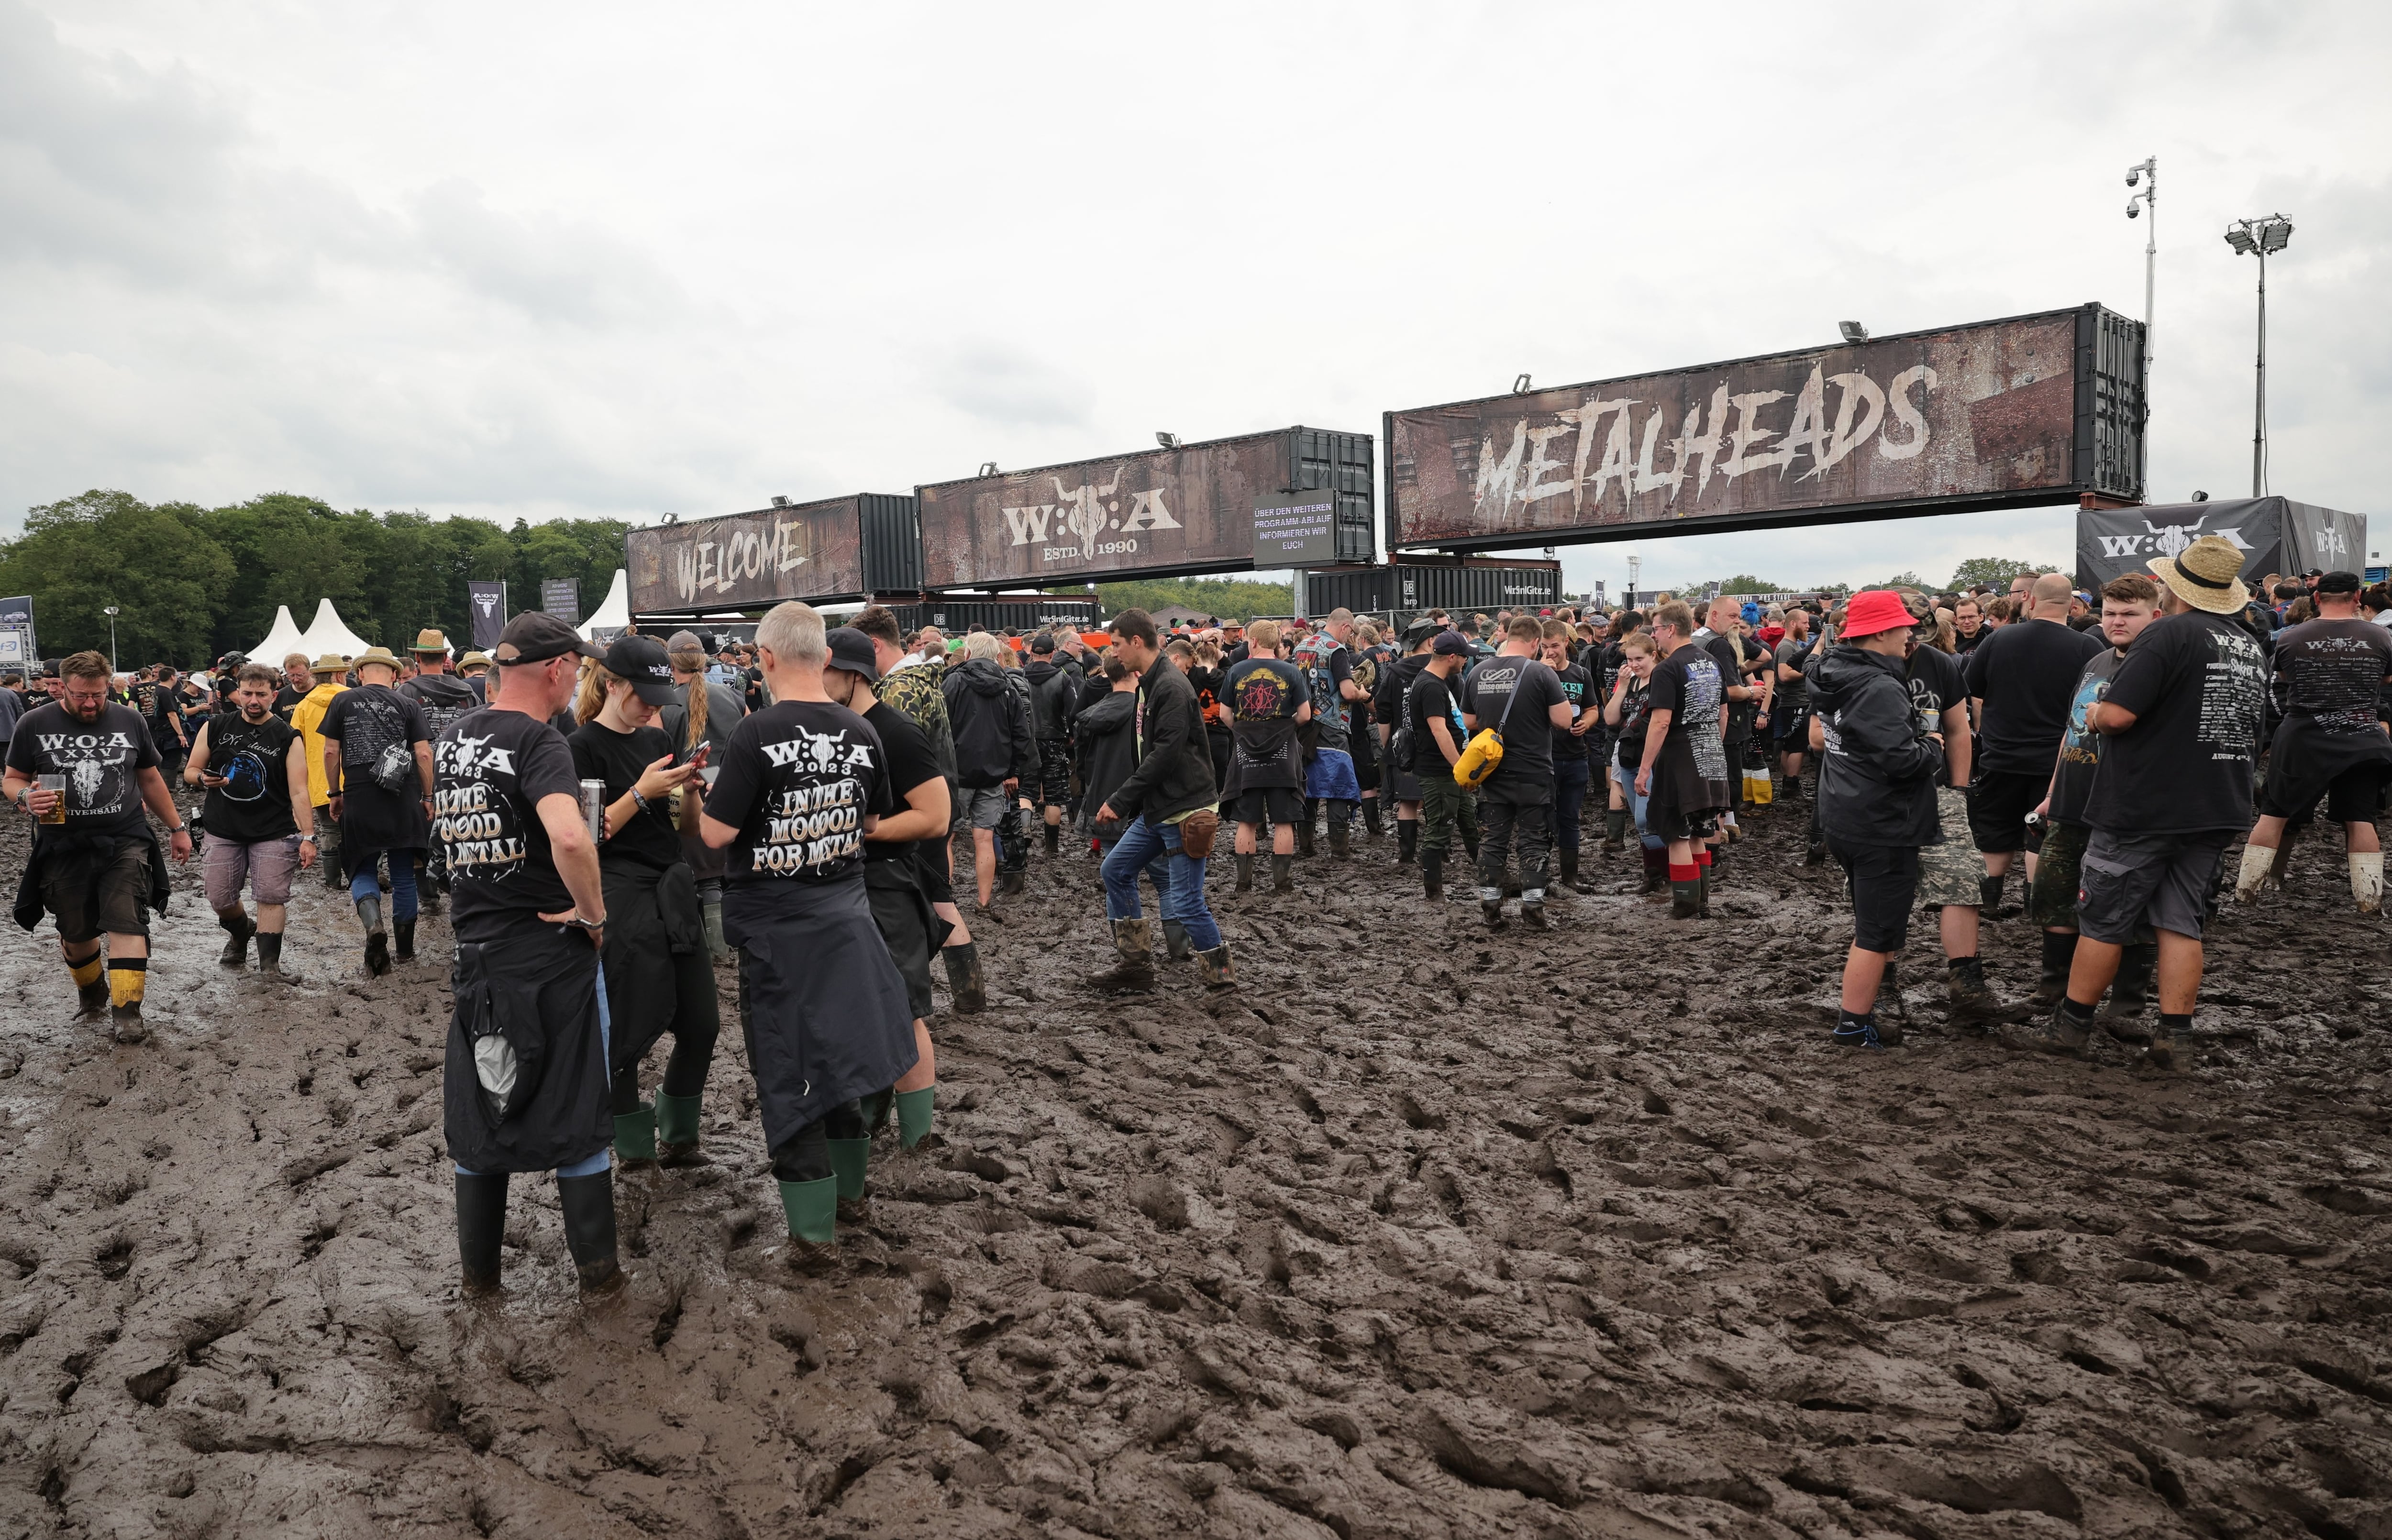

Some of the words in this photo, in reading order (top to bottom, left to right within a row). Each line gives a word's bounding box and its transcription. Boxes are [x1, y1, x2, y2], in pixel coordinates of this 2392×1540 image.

[1474, 360, 1938, 521] METALHEADS
[1254, 508, 1274, 517] ÜBER
[1276, 507, 1291, 515] DEN
[1293, 503, 1331, 514] WEITEREN
[1254, 515, 1332, 528] PROGRAMM-ABLAUF
[1260, 528, 1310, 539] INFORMIEREN
[1312, 527, 1327, 535] WIR
[1043, 547, 1081, 562] ESTD.
[1097, 538, 1137, 554] 1990
[1283, 540, 1303, 550] EUCH
[677, 513, 810, 605] WELCOME
[935, 615, 945, 624] DB
[2229, 647, 2254, 659] 2022
[1561, 682, 1584, 695] KEN
[36, 732, 134, 752] W:O:A
[64, 748, 112, 759] XXV
[438, 760, 482, 779] 2023
[794, 760, 852, 776] 2023
[448, 786, 488, 813] THE
[782, 789, 810, 817] IN
[813, 782, 854, 810] THE
[64, 803, 122, 816] NIVERSARY
[752, 844, 804, 872] FOR
